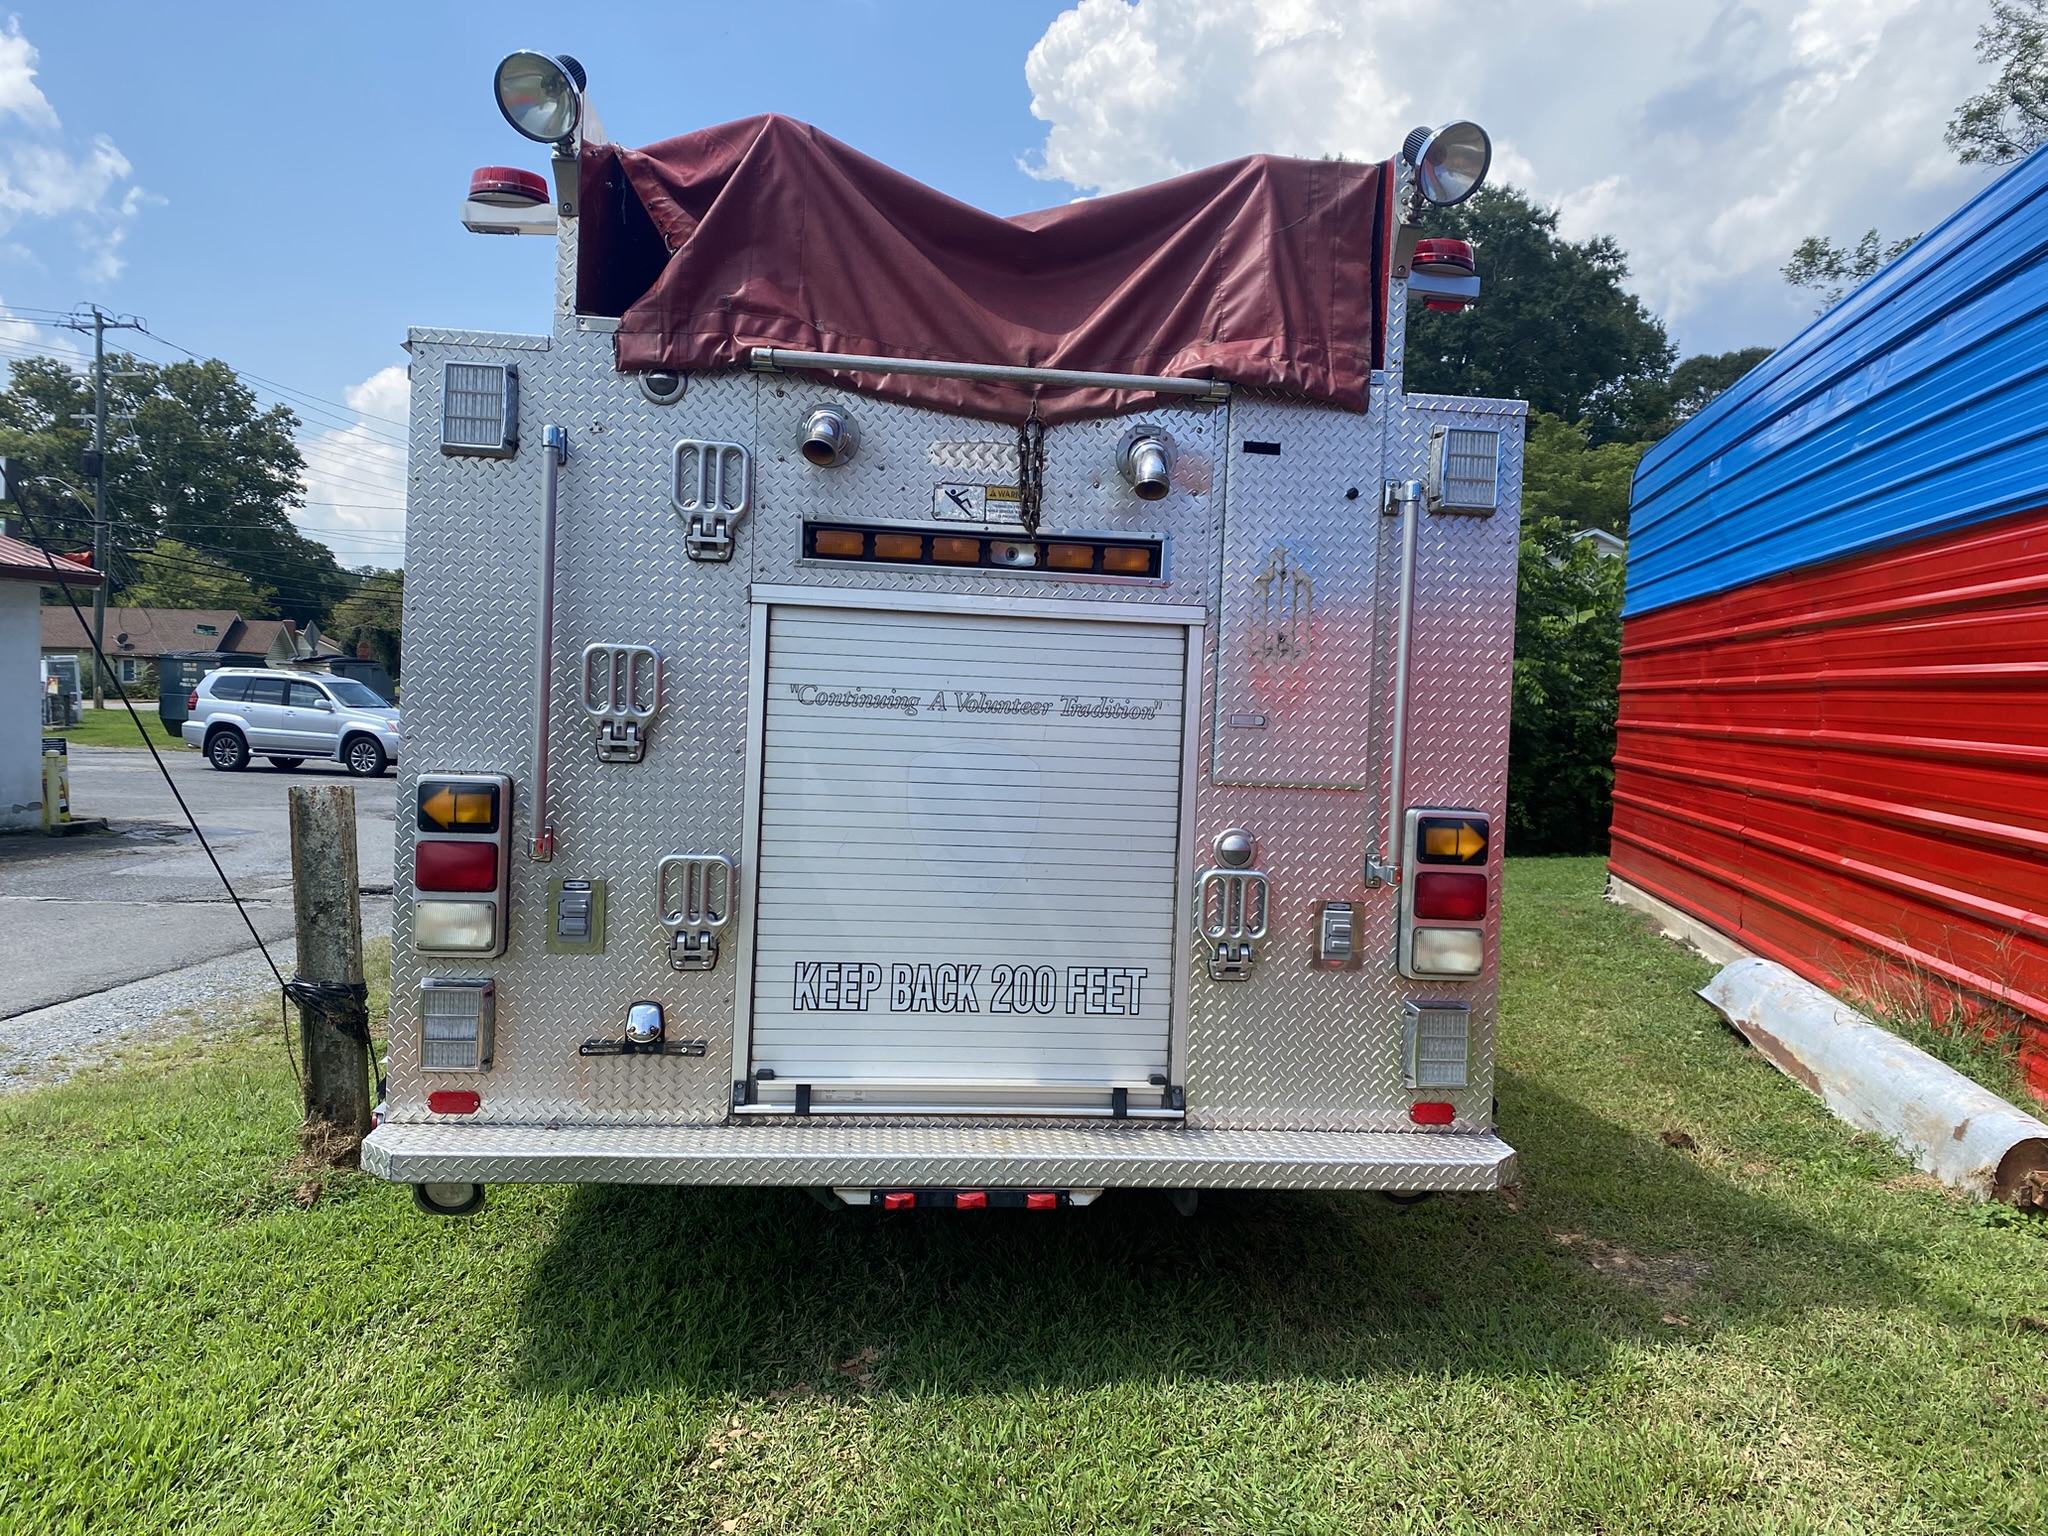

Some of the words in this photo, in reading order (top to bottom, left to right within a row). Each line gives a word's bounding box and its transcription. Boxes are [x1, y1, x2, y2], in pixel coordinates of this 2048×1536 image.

[790, 684, 921, 716] "Continuing
[927, 691, 947, 712] A
[954, 691, 1053, 716] Volunteer
[1060, 695, 1163, 721] Tradition"
[793, 962, 882, 1012] KEEP
[890, 963, 982, 1013] BACK
[989, 964, 1057, 1014] 200
[1065, 966, 1148, 1016] FEET
